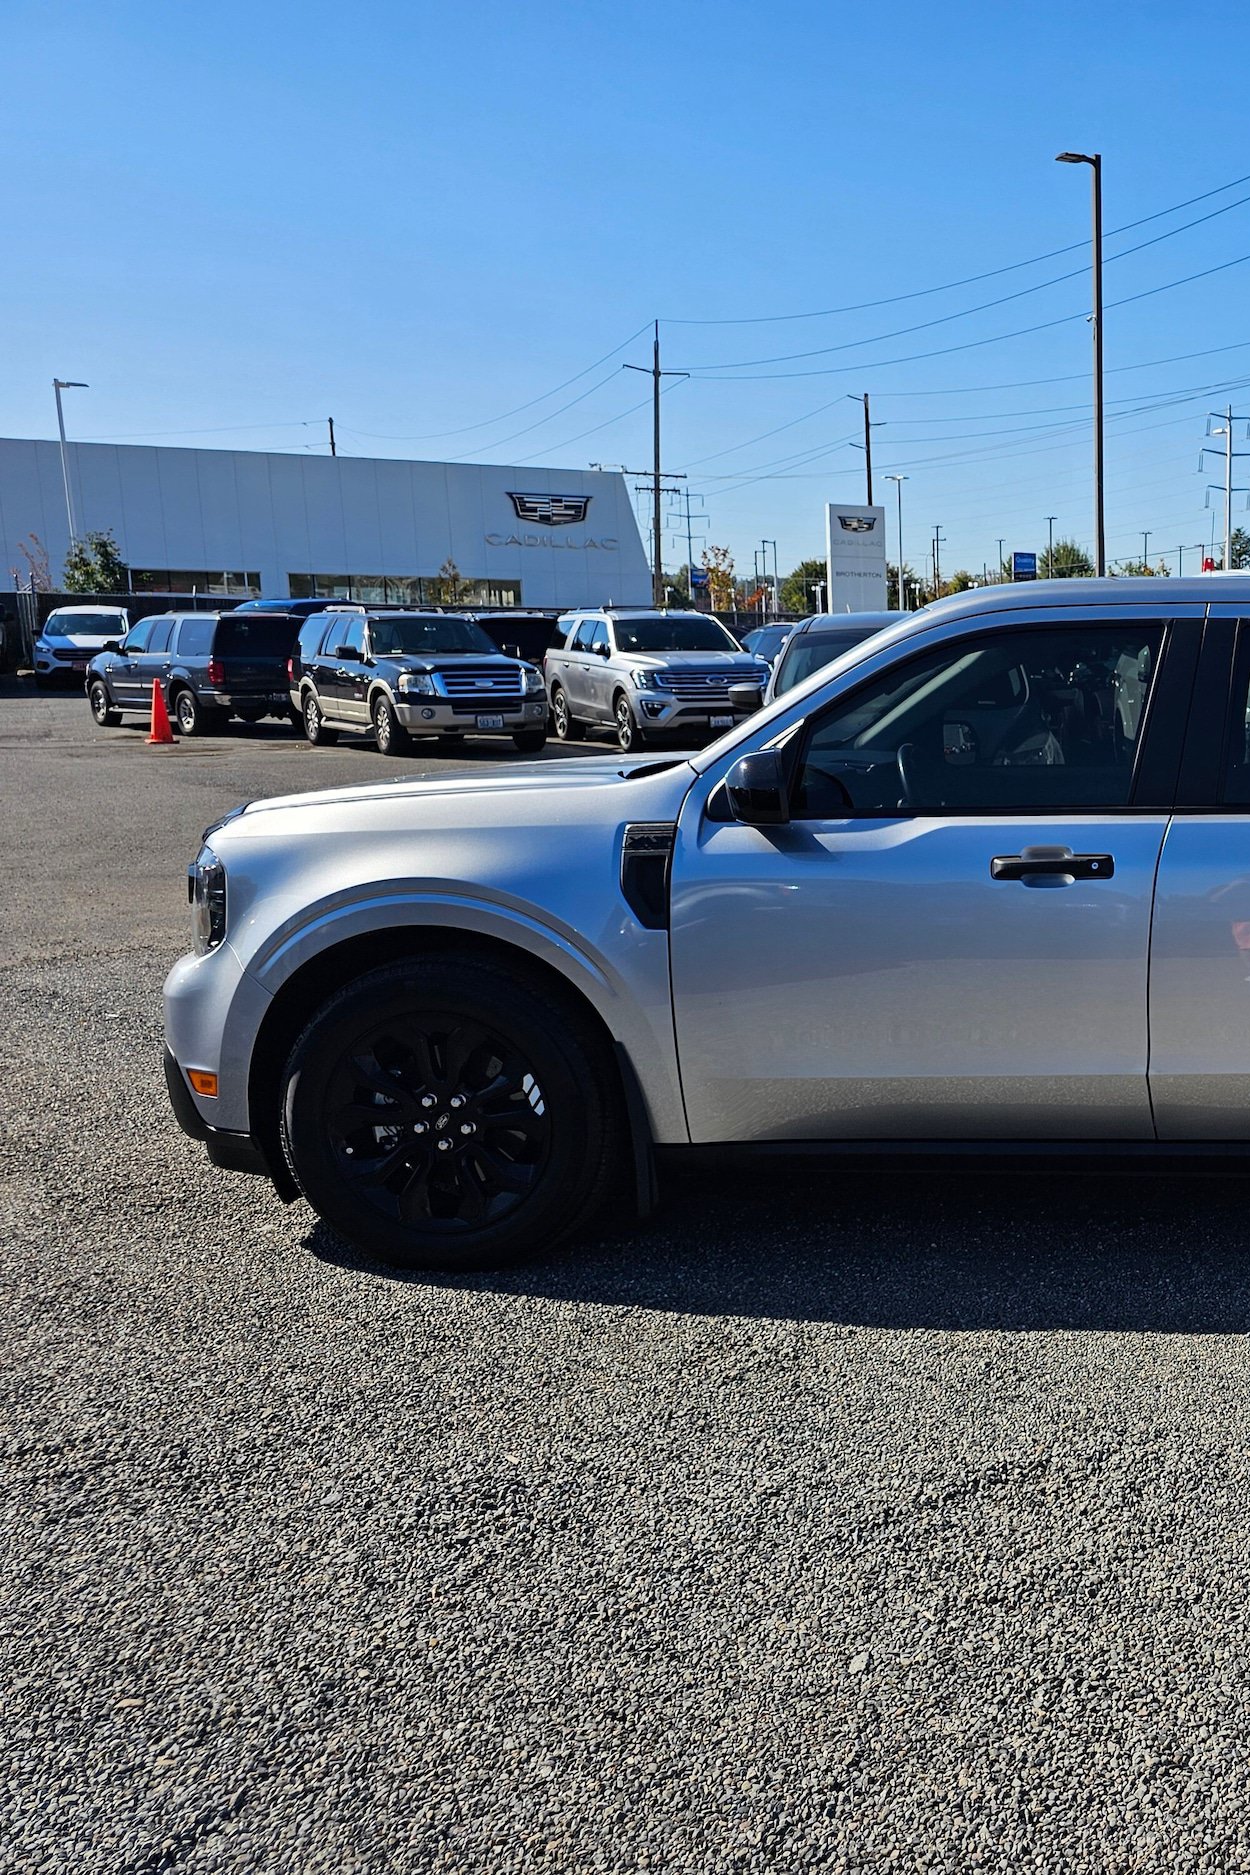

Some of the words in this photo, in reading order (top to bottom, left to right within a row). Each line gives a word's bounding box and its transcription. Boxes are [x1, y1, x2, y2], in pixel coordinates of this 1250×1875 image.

[484, 533, 619, 550] CADILLAC
[833, 539, 883, 547] CADILLAC
[835, 570, 882, 578] BROTHERTON
